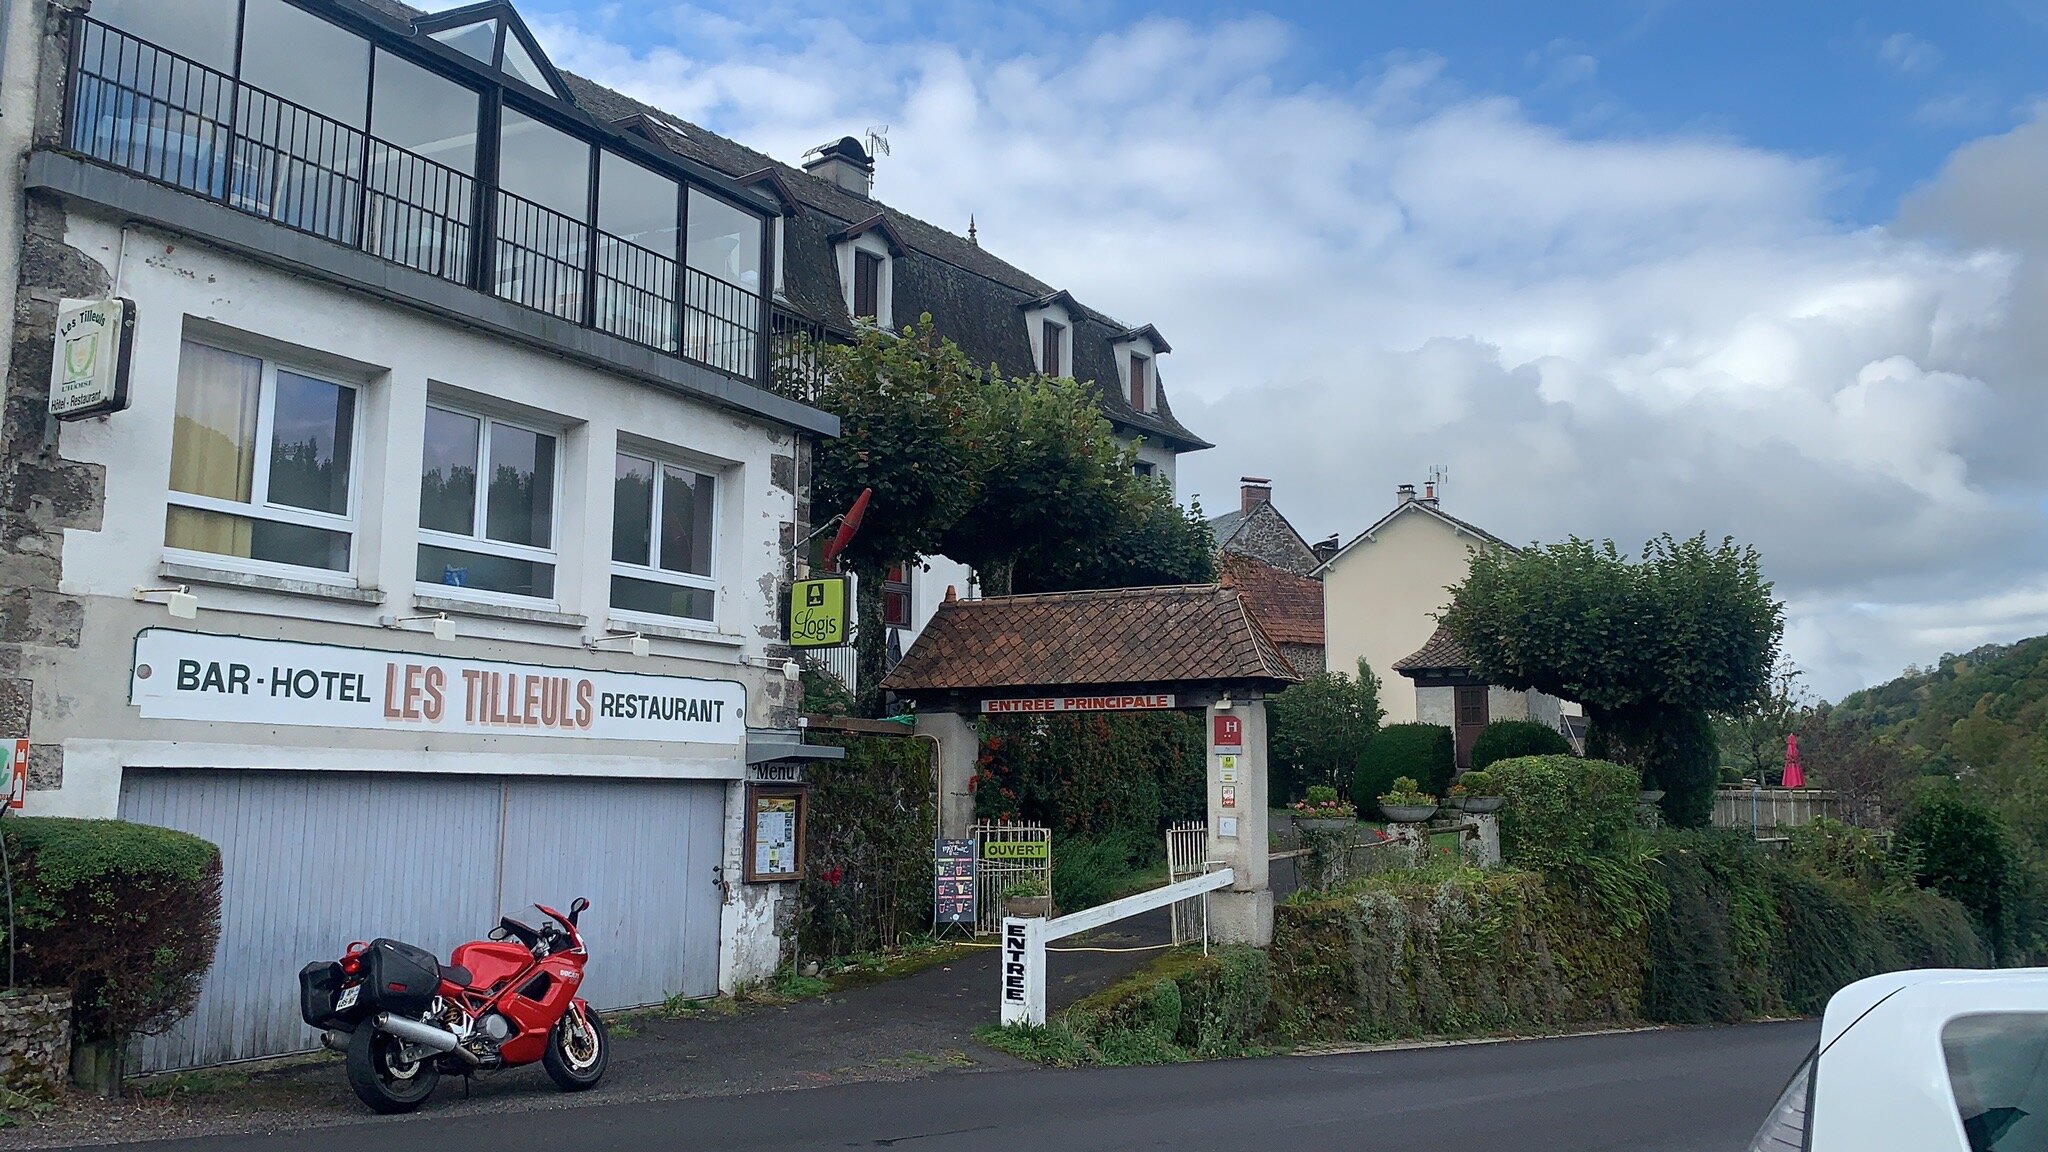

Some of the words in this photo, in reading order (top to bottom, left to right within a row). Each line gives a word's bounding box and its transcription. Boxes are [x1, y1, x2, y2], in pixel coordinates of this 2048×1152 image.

[61, 319, 76, 337] Les
[80, 310, 105, 326] Tilleuls
[51, 399, 65, 411] Hôtel
[70, 390, 101, 406] Restaurant
[792, 607, 837, 641] Logis
[177, 658, 250, 695] BAR
[270, 666, 371, 703] HOTEL
[383, 662, 447, 723] LES
[462, 668, 595, 731] TILLEULS
[600, 692, 724, 723] RESTAURANT
[1063, 695, 1168, 710] PRINCIPALE
[1226, 721, 1238, 733] H
[752, 762, 794, 780] Menu
[988, 845, 1044, 856] OUVERT
[1006, 924, 1026, 1001] ENTREE
